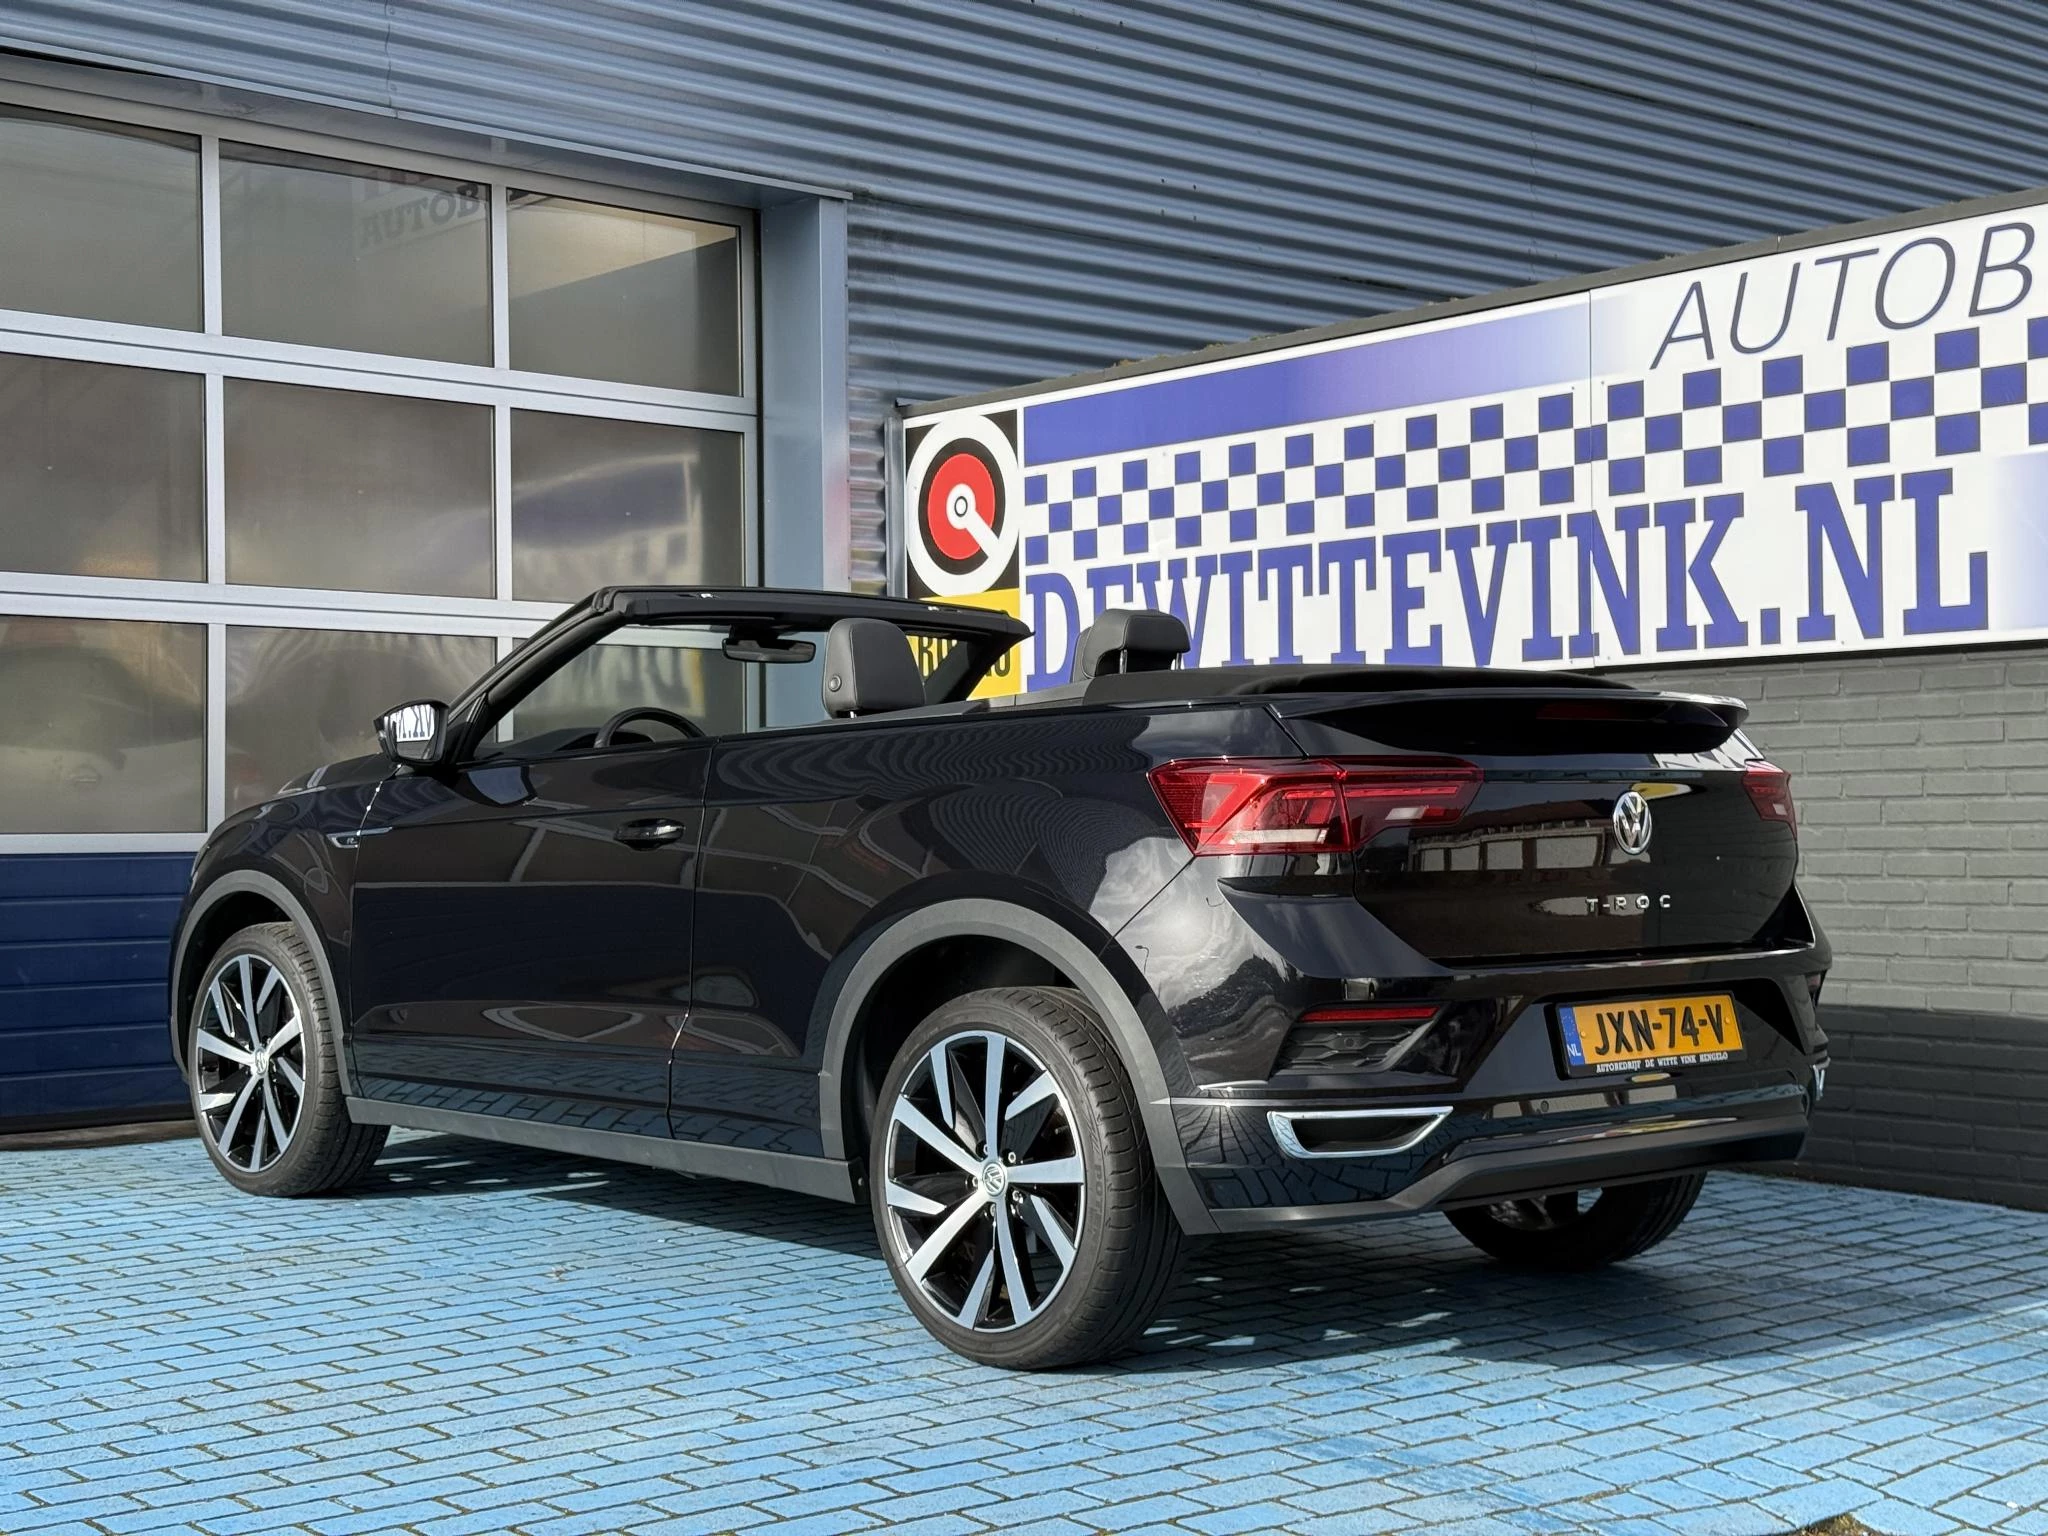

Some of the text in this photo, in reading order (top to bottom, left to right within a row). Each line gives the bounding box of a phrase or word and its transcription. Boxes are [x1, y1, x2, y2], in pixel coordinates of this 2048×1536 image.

[1649, 222, 2035, 370] AUTOB
[1594, 1003, 1724, 1056] JXN-74-V
[1566, 1043, 1582, 1057] NL
[1645, 1058, 1655, 1068] DE
[1658, 1056, 1678, 1067] WITTE
[1680, 1054, 1697, 1065] VINK
